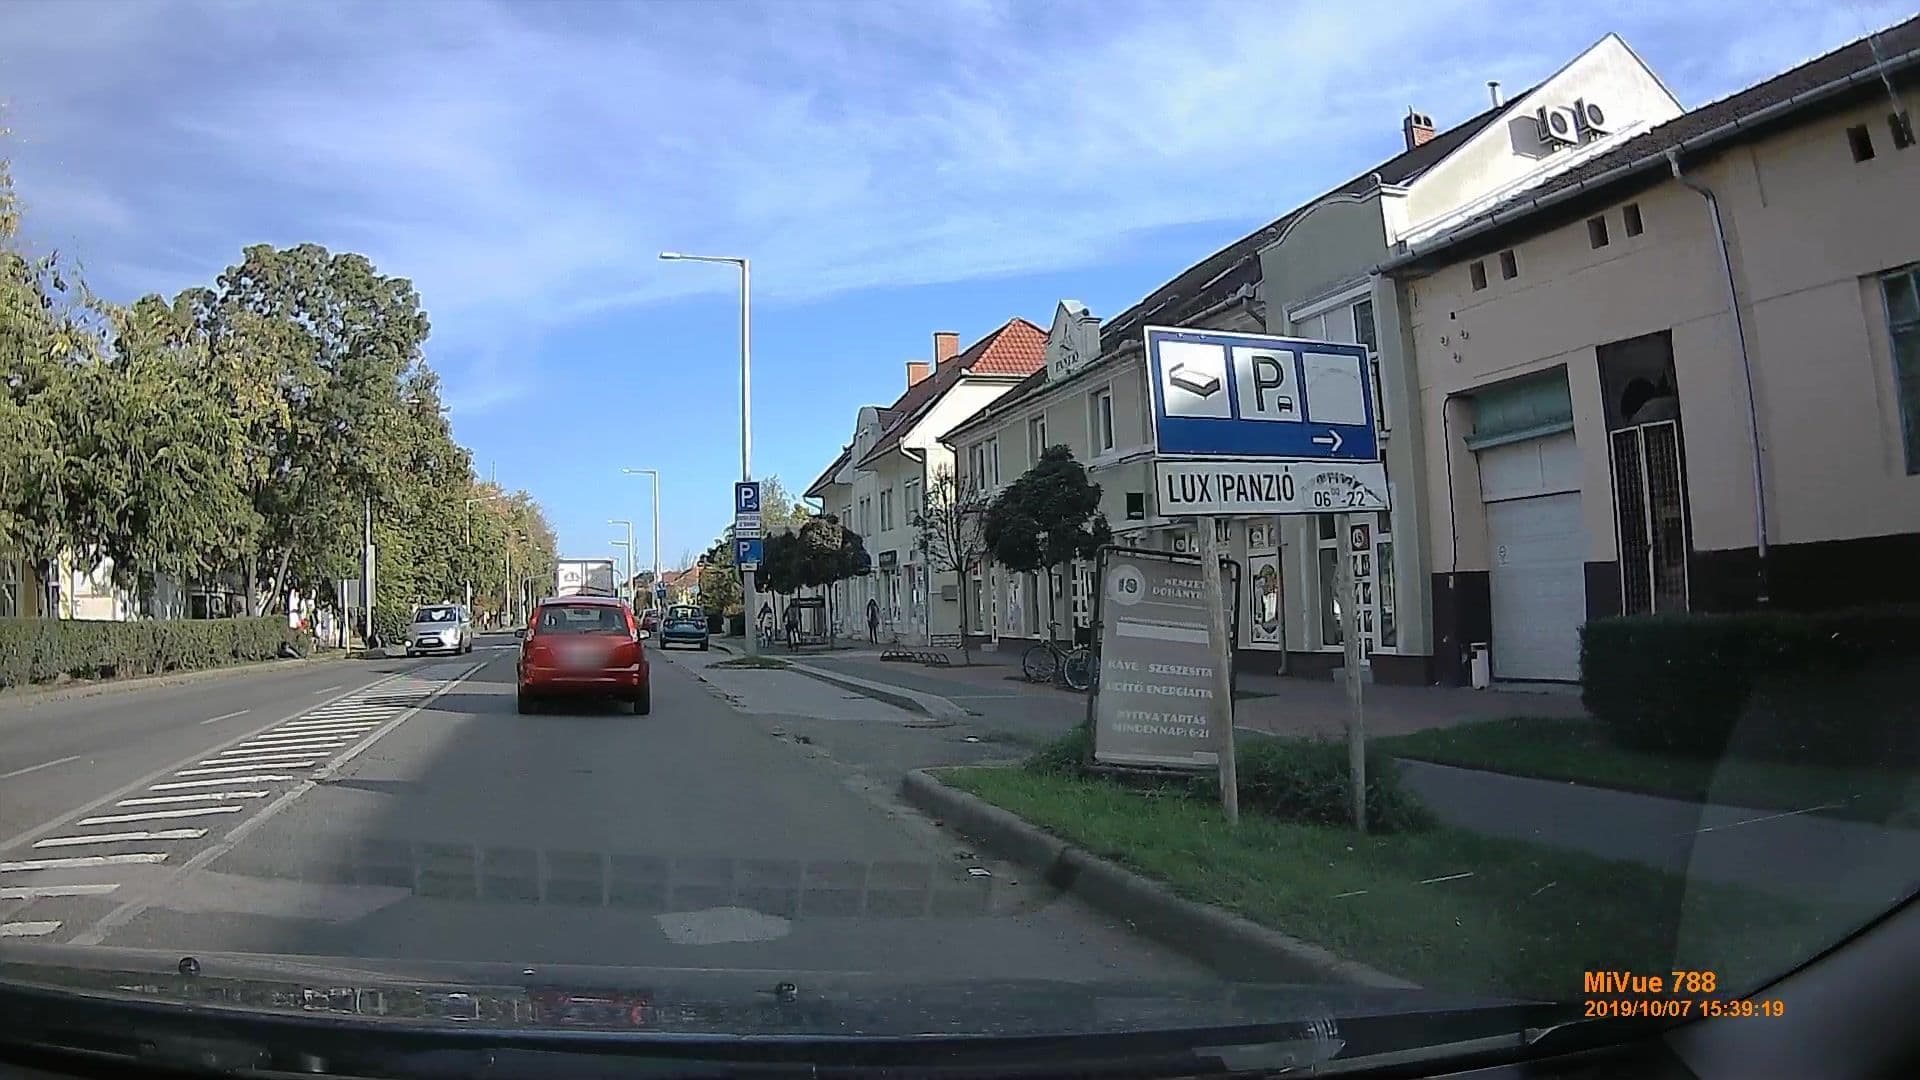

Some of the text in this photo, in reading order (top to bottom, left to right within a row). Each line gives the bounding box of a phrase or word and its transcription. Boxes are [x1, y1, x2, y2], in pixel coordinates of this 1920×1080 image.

[1251, 355, 1284, 412] P
[1167, 465, 1295, 503] LUX PANZIÓ
[741, 487, 754, 508] P
[739, 541, 751, 557] P
[1164, 578, 1206, 589] NEMZET
